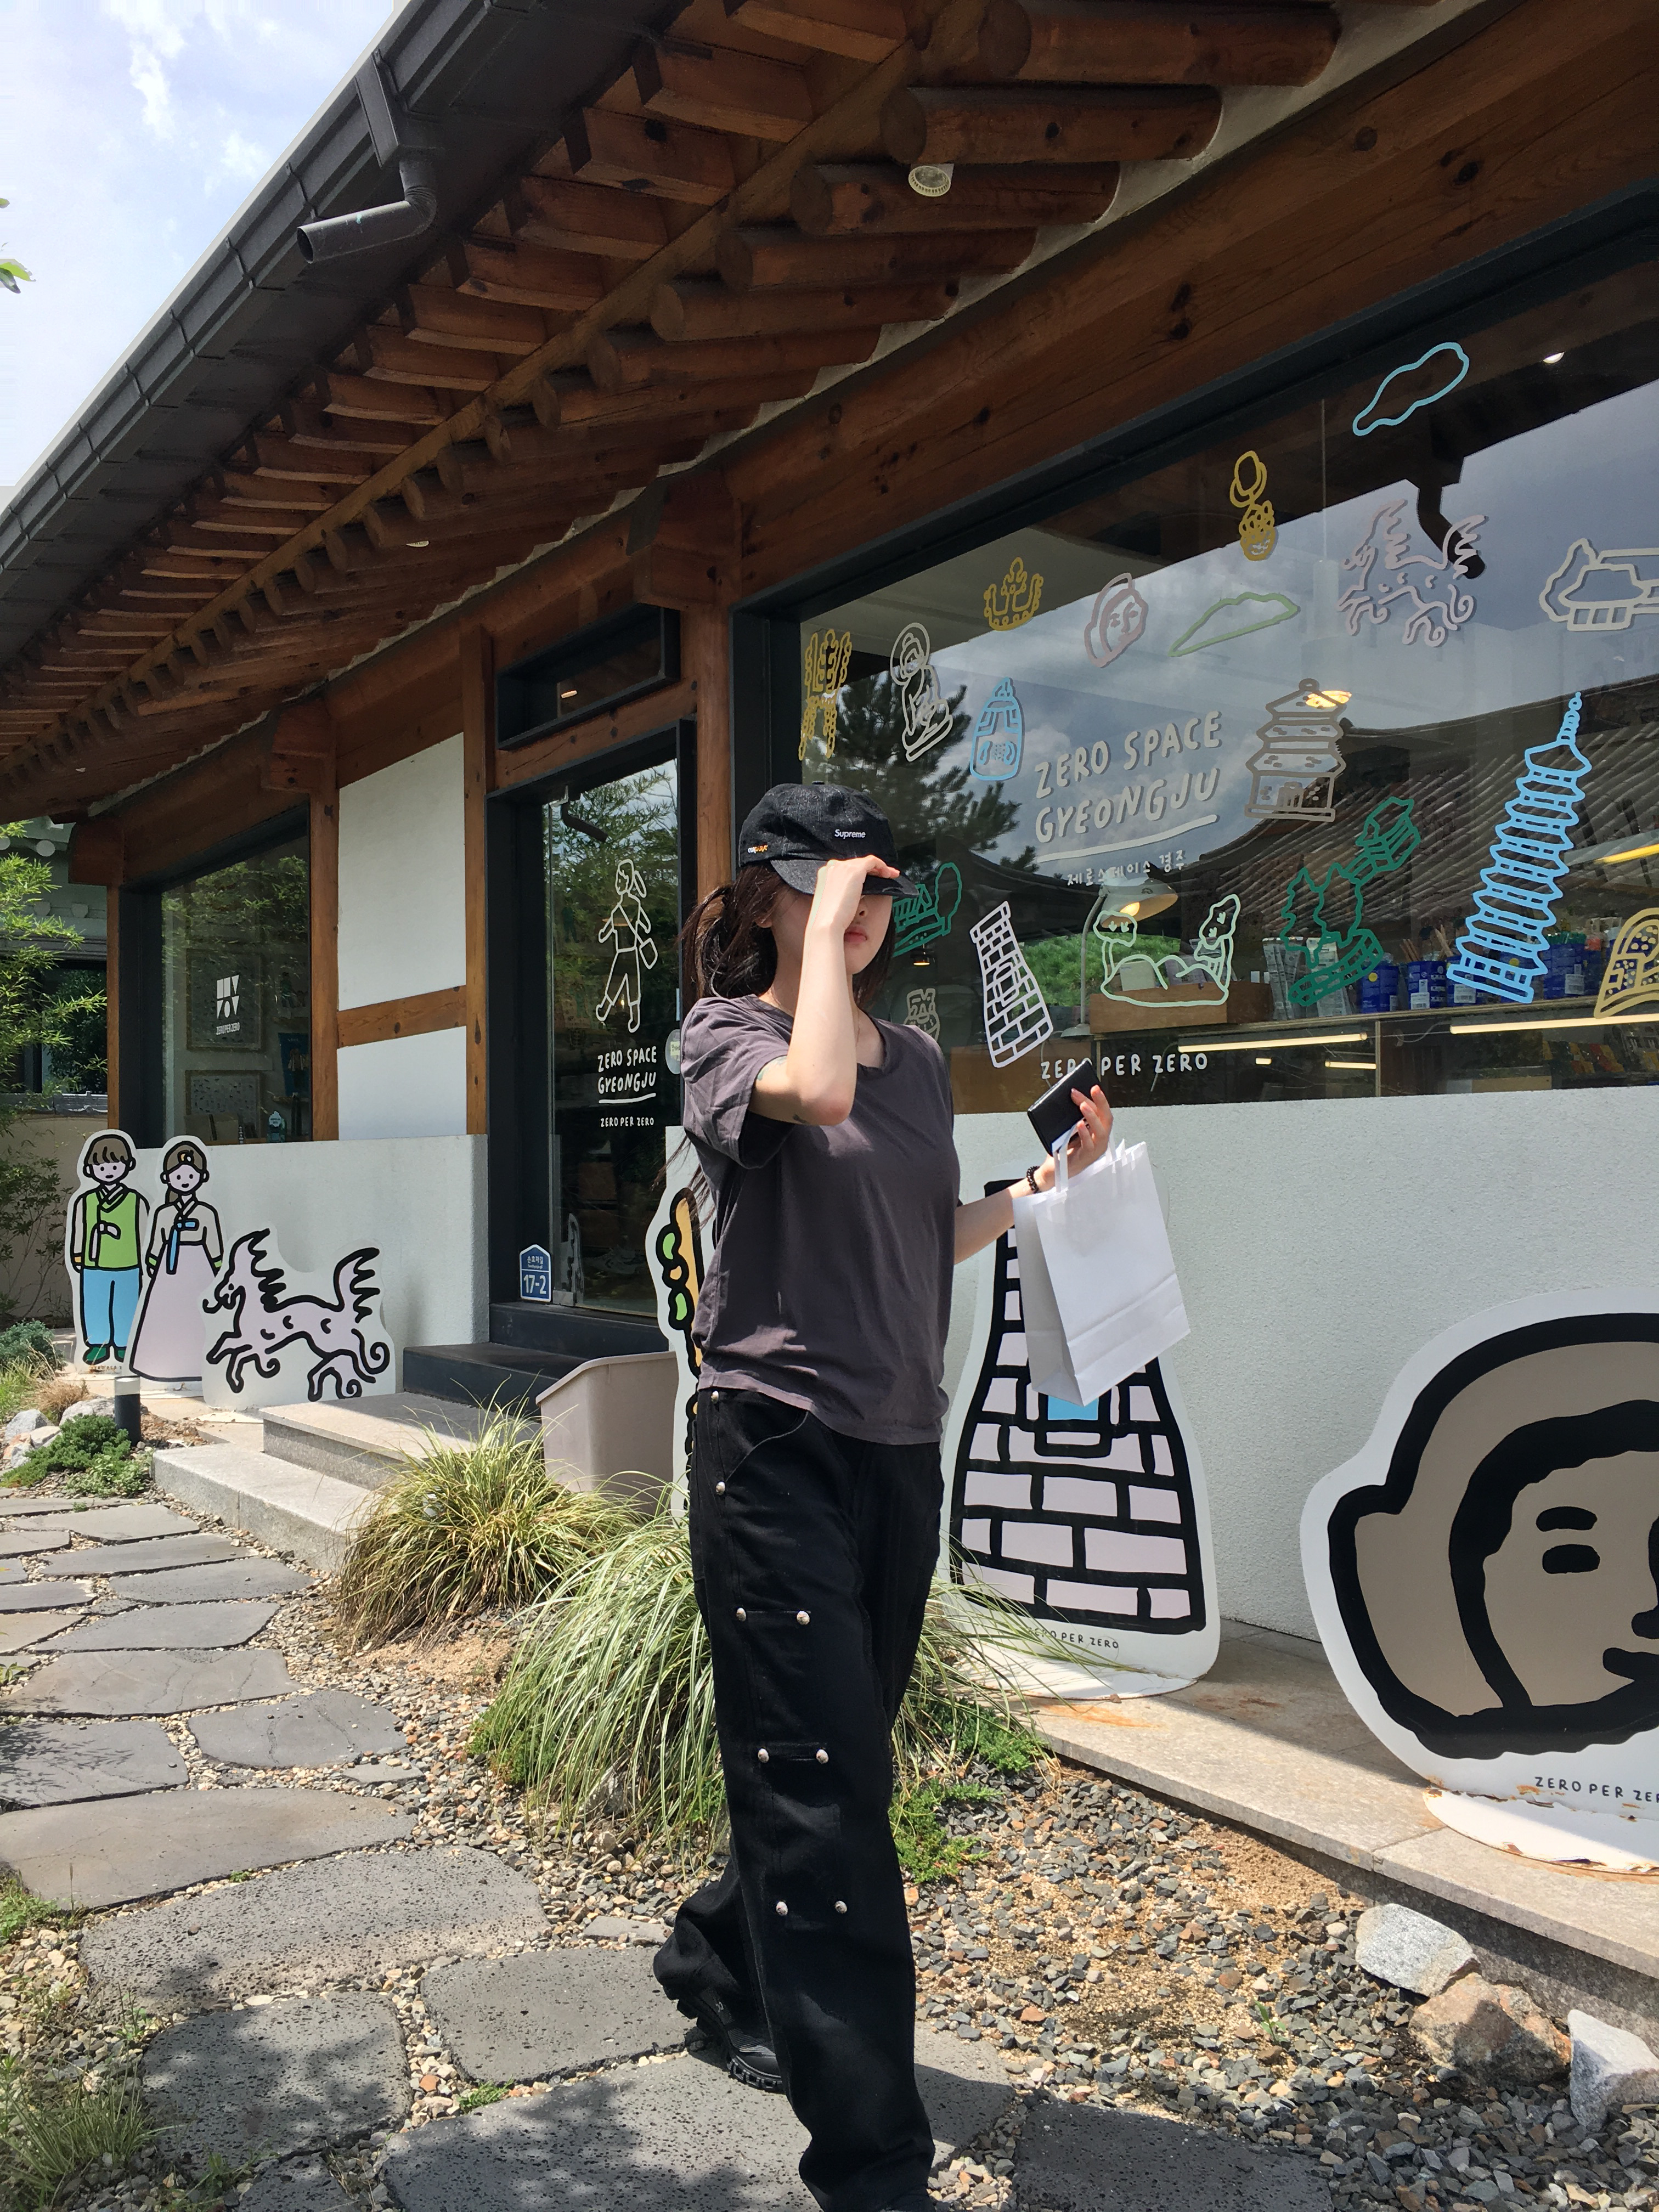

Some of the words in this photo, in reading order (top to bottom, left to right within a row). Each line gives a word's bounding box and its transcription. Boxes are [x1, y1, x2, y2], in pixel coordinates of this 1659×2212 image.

[1035, 740, 1110, 799] ZERO
[1123, 711, 1221, 770] SPACE
[1035, 768, 1220, 843] GYEONGJU
[834, 829, 866, 839] Supreme
[1159, 849, 1184, 873] 경주
[597, 1049, 623, 1073] ZERO
[627, 1046, 657, 1066] SPACE
[1041, 1057, 1092, 1079] ZER
[1101, 1053, 1141, 1076] PER
[1152, 1053, 1207, 1074] ZERO
[598, 1071, 656, 1094] GYEONGJU
[600, 1117, 618, 1127] ZERO
[620, 1116, 634, 1126] PER
[636, 1117, 654, 1126] ZERO
[523, 1274, 546, 1294] 17-2
[1062, 1632, 1084, 1644] PER
[1090, 1637, 1119, 1649] ZERO
[1534, 1776, 1581, 1792] ZERO
[1589, 1784, 1623, 1798] PER
